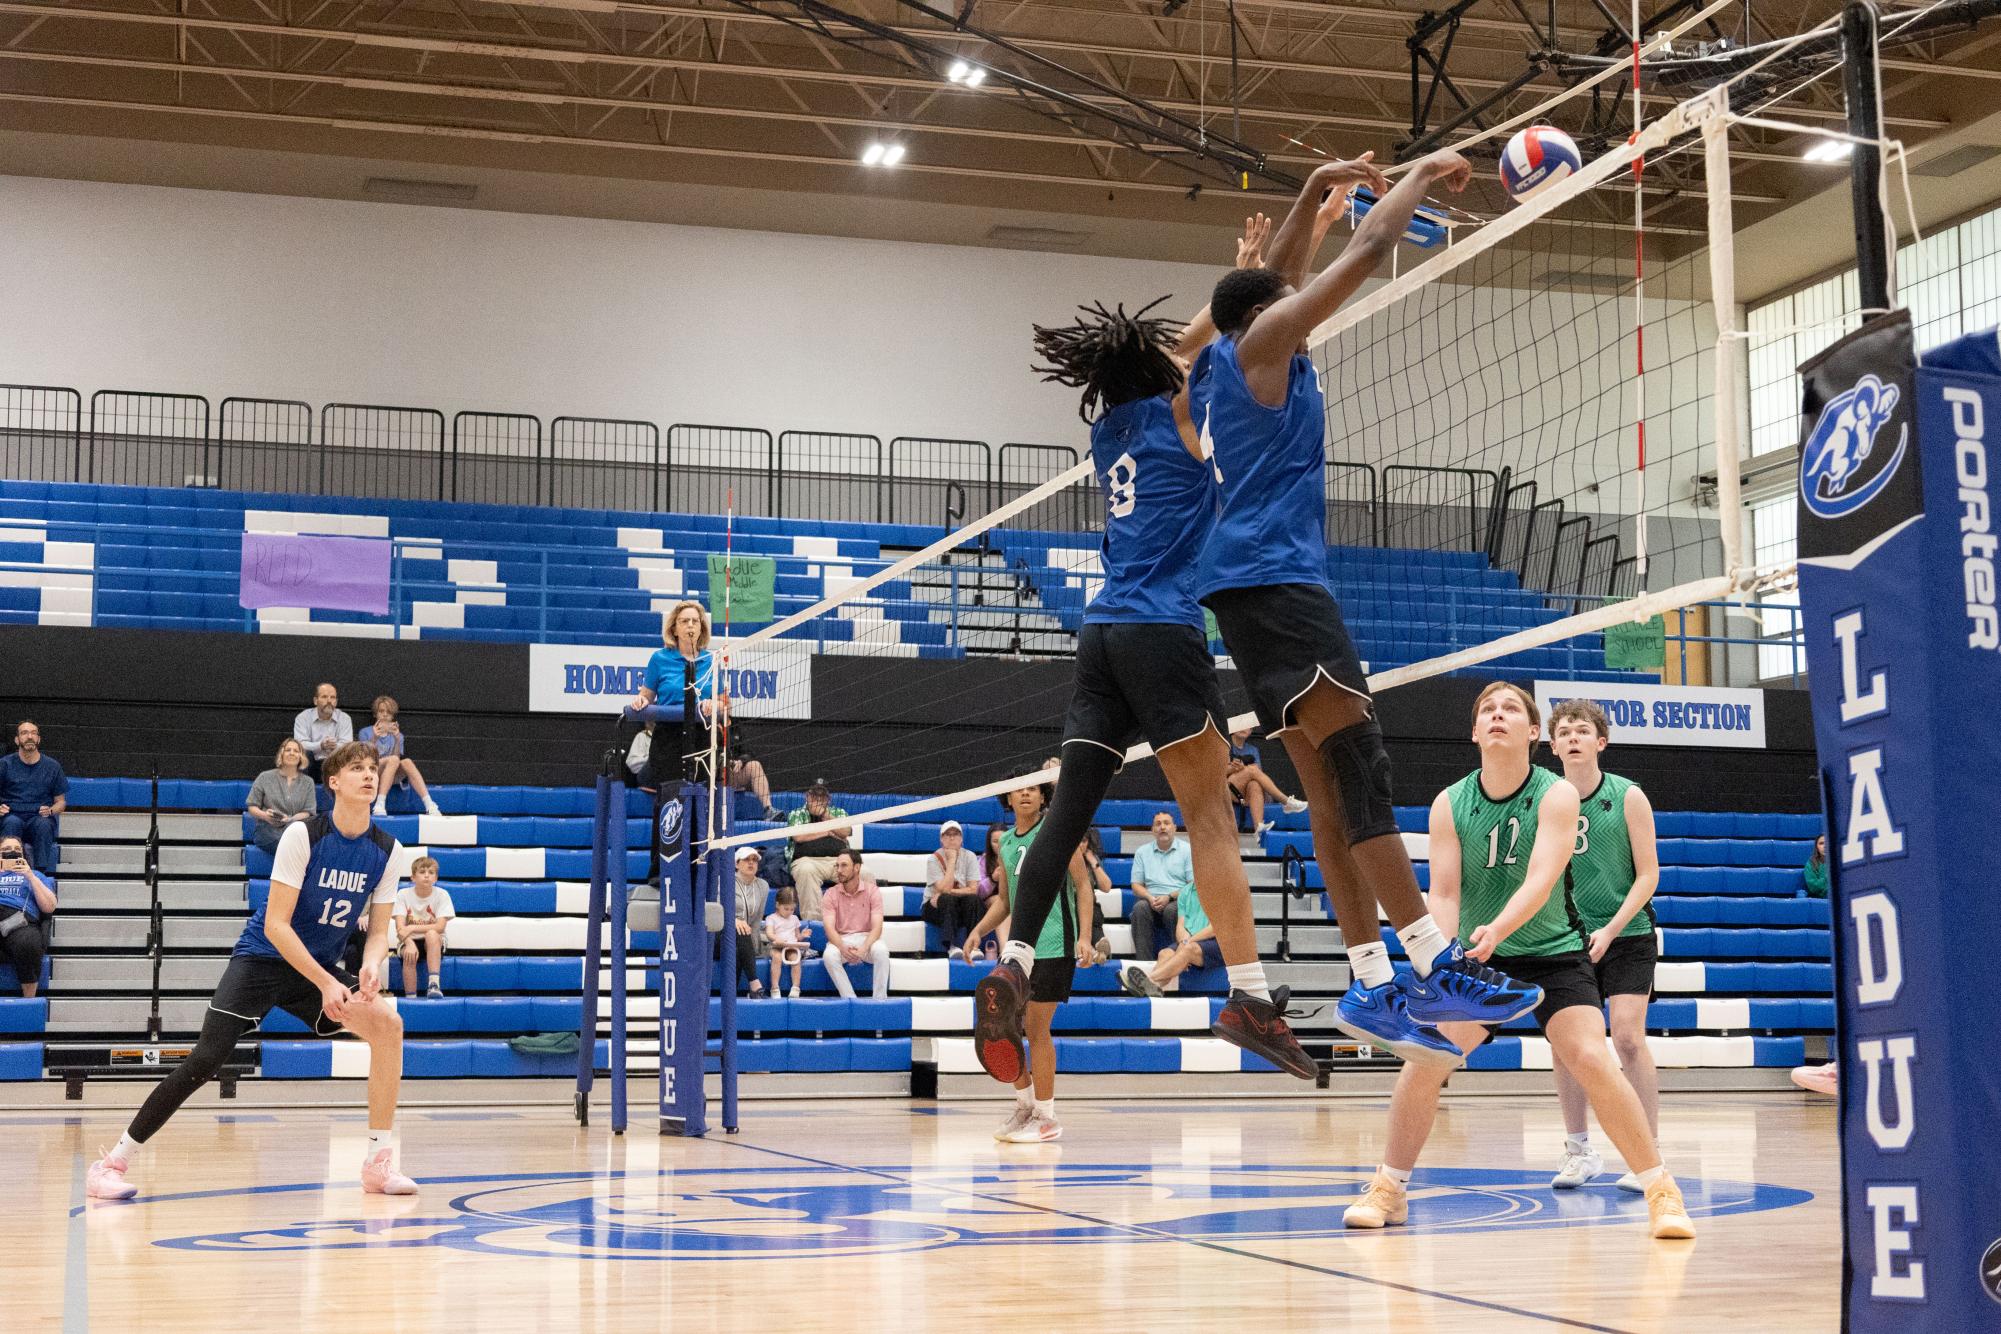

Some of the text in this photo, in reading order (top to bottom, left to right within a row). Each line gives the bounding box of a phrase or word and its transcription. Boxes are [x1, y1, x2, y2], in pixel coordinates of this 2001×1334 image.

[1107, 452, 1137, 518] 8
[1653, 701, 1751, 730] SECTION
[1485, 816, 1520, 868] 12
[318, 867, 368, 893] LADUE
[318, 897, 352, 928] 12
[1834, 611, 1926, 1298] LADUE
[662, 877, 679, 1104] LADUE
